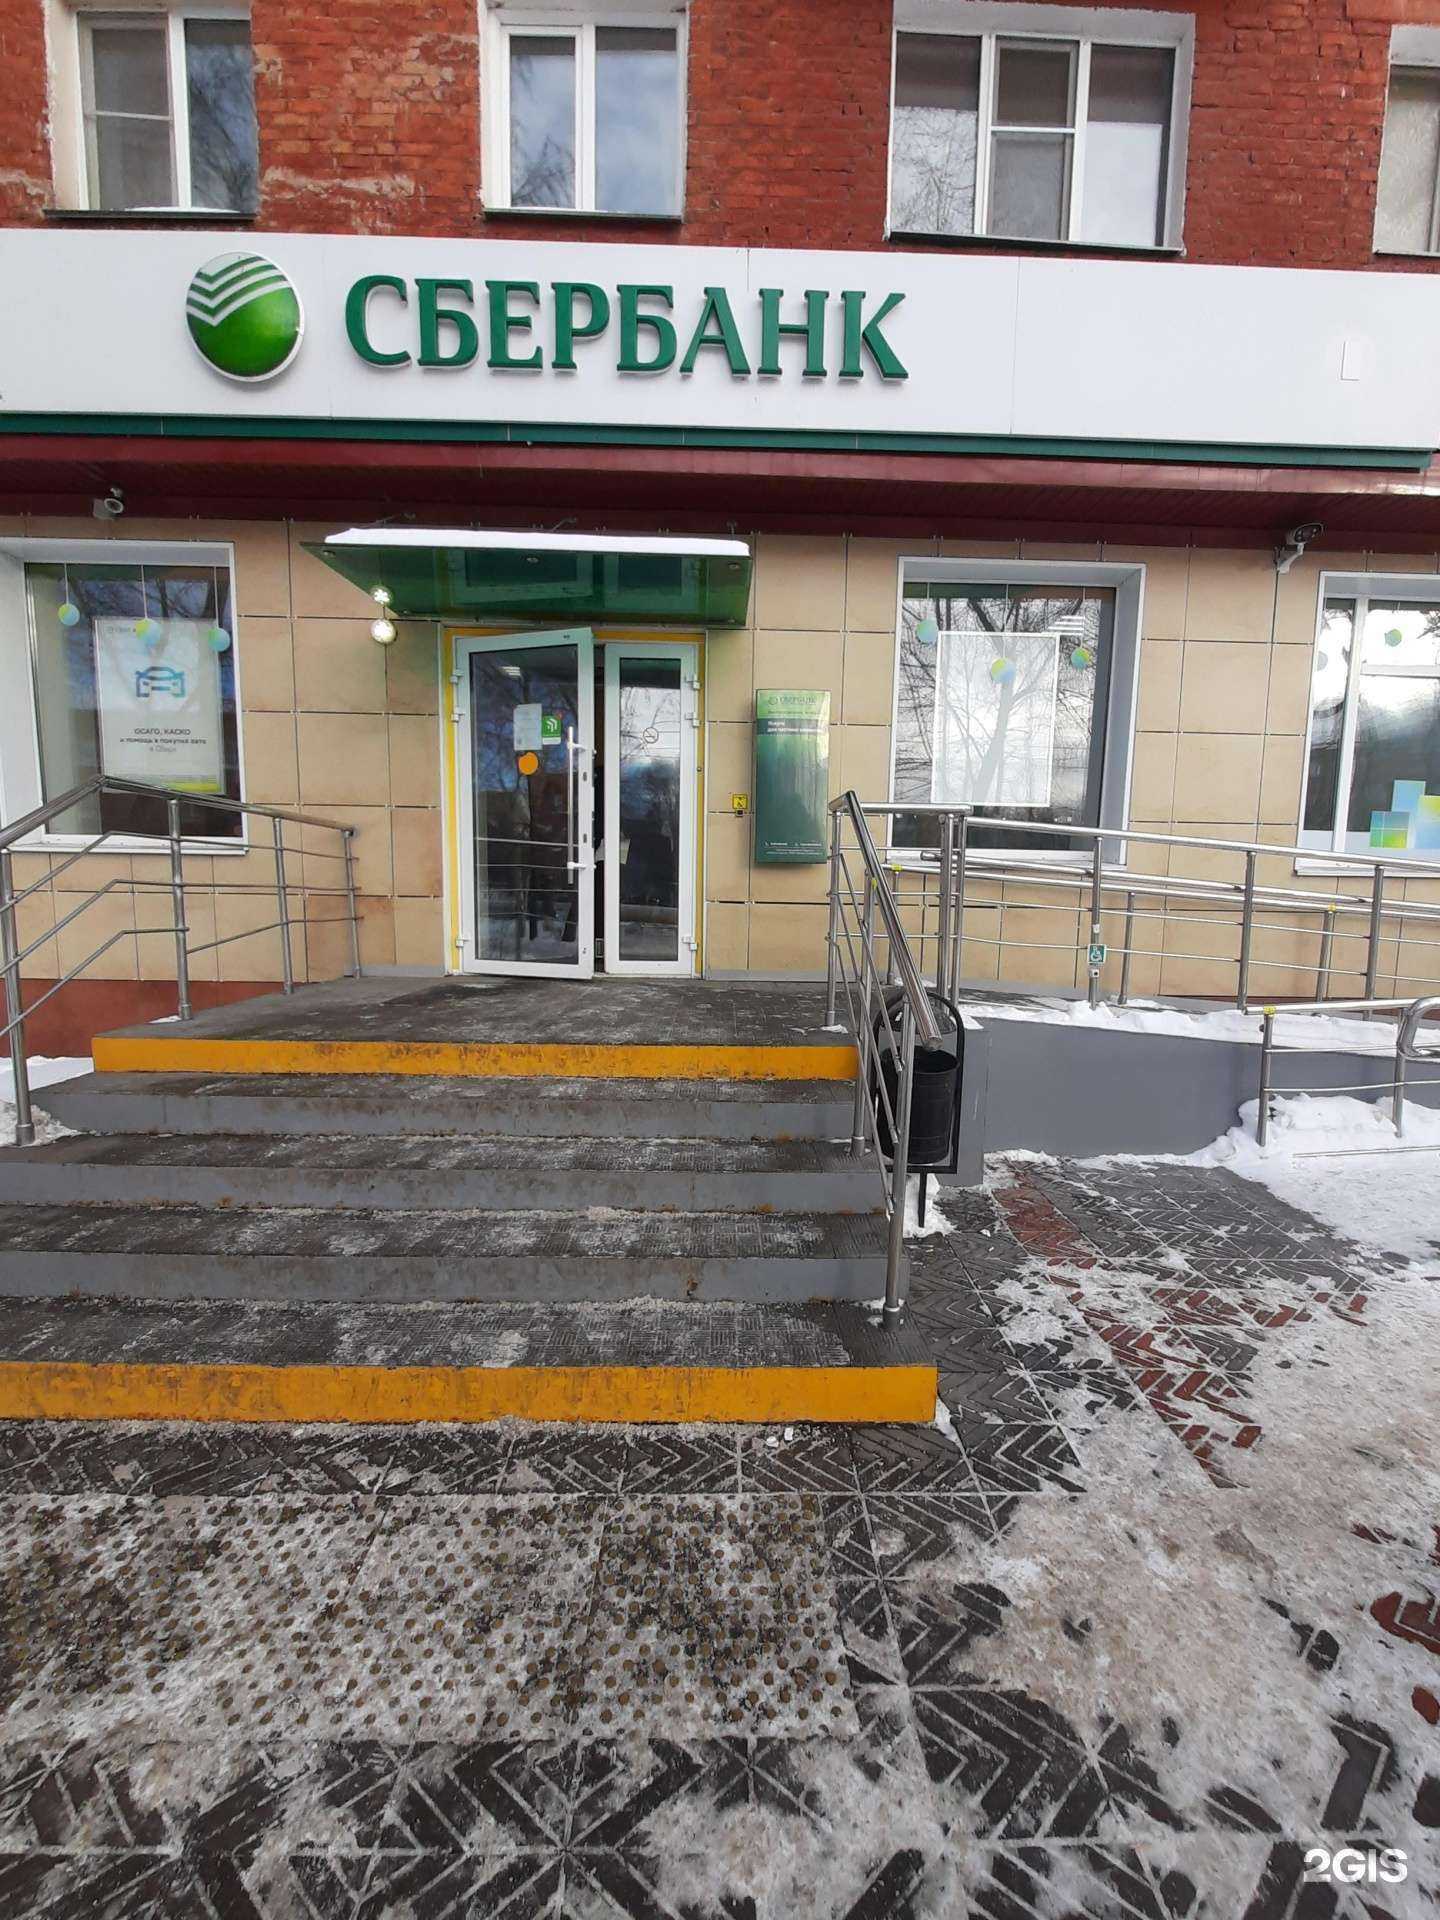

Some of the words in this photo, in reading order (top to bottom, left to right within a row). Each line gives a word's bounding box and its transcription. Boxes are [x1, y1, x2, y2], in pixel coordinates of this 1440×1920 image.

[345, 274, 909, 381] СБЕРБАНК
[134, 727, 162, 736] ОСАГО,
[164, 728, 191, 736] КАСКО
